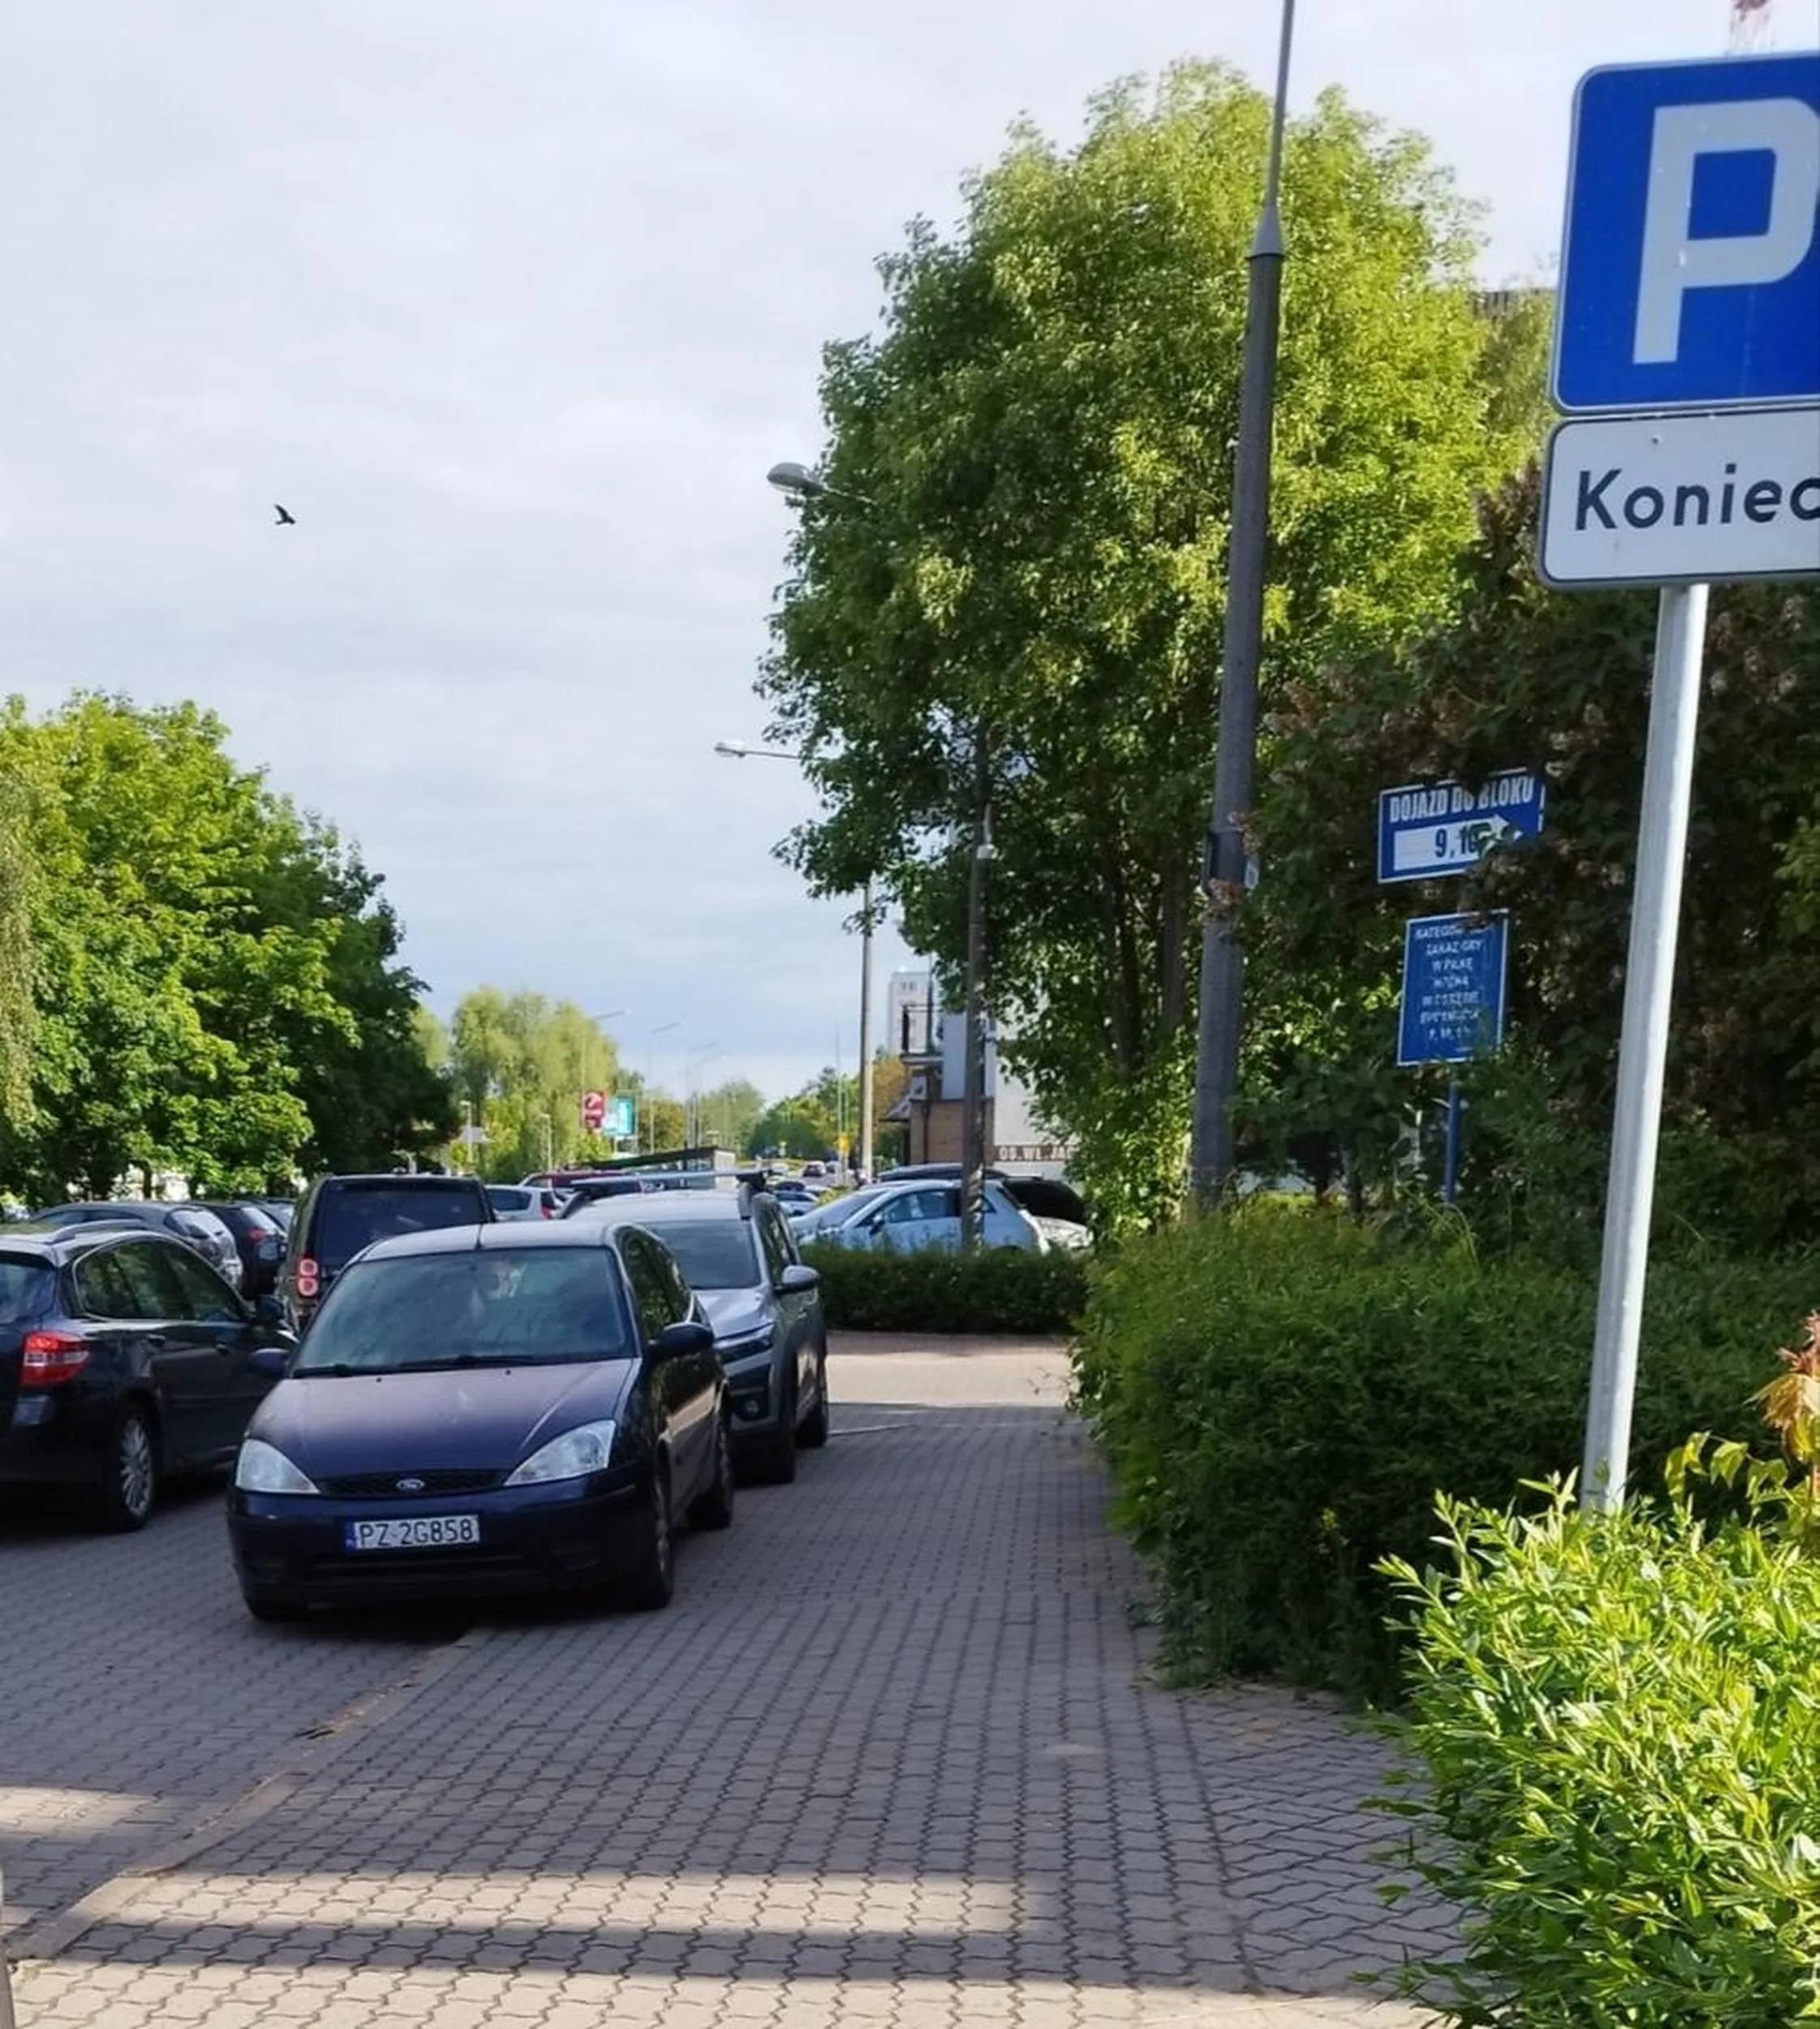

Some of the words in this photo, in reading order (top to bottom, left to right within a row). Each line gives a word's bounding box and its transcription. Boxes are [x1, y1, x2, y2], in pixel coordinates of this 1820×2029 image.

[1632, 96, 1820, 364] P
[1574, 463, 1820, 531] Koniec
[1389, 788, 1449, 823] DOJAZD
[1451, 786, 1475, 814] DO
[1478, 775, 1536, 811] BLOKU
[359, 1522, 391, 1547] PZ
[398, 1517, 474, 1545] 2G858
